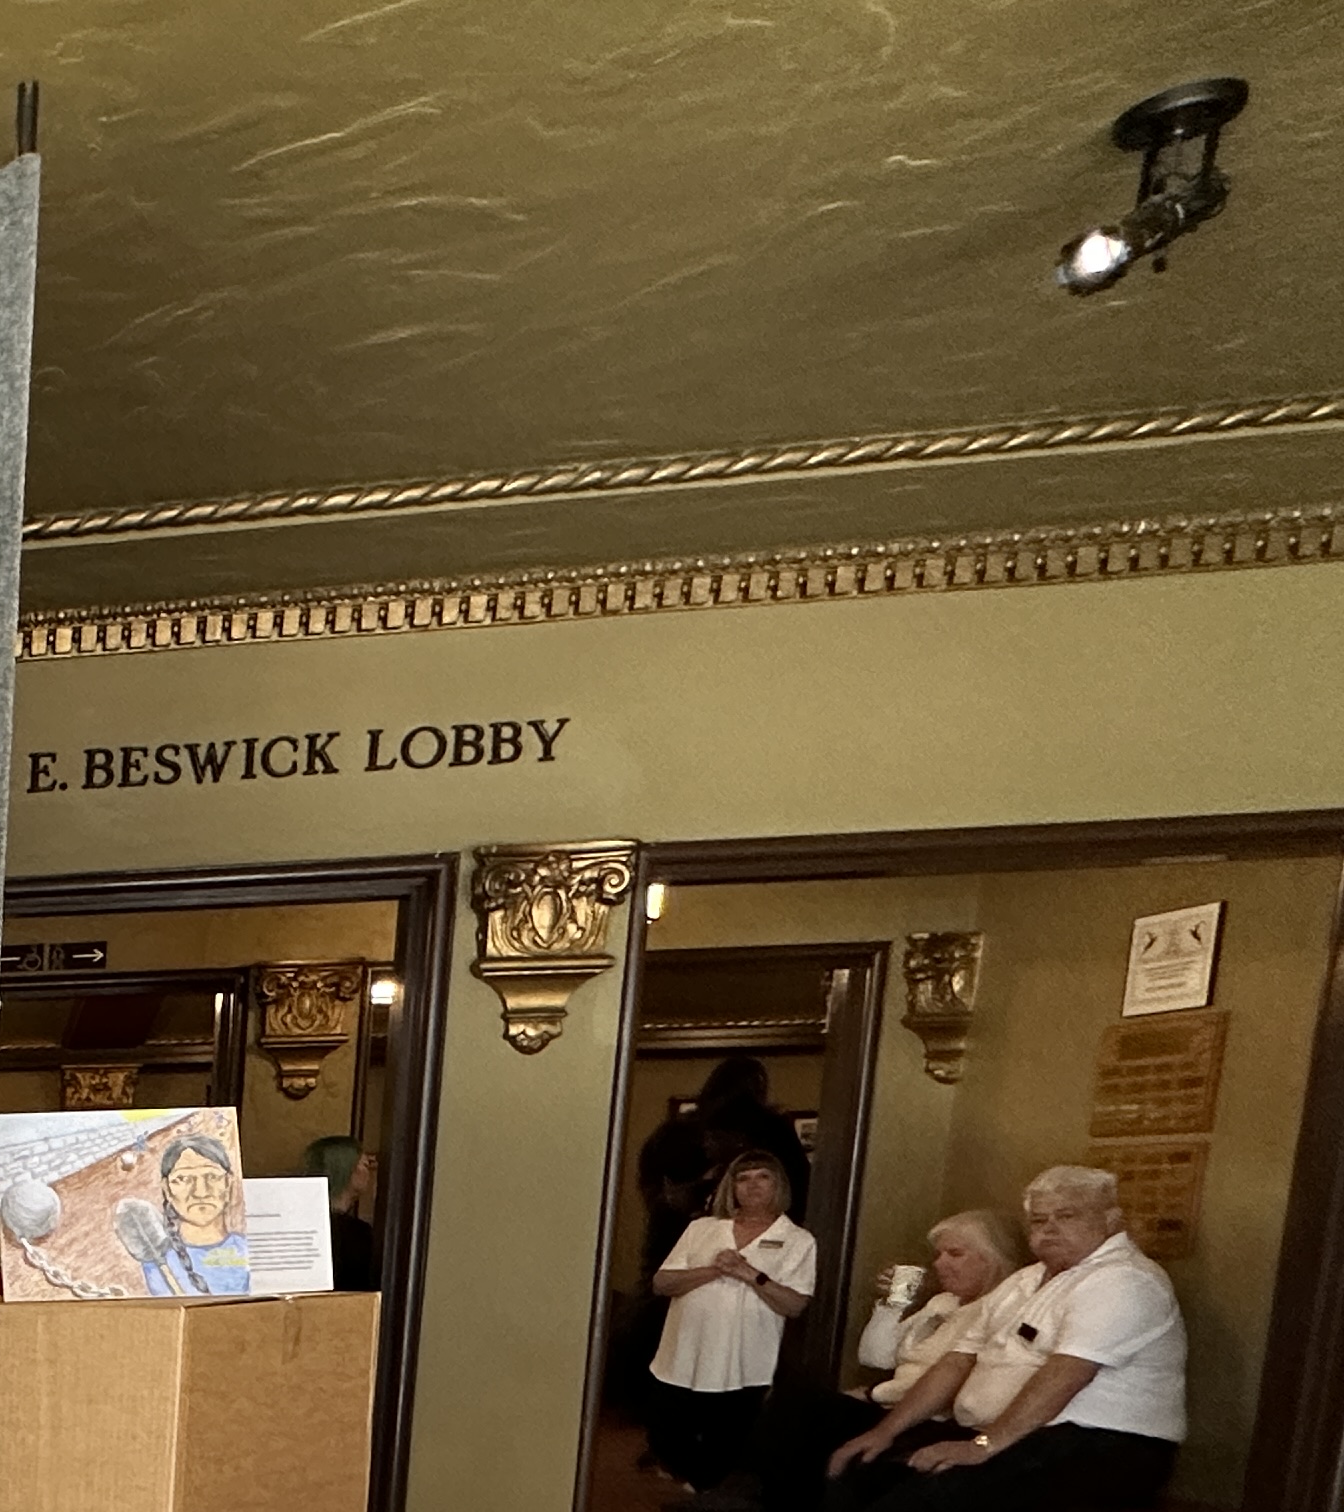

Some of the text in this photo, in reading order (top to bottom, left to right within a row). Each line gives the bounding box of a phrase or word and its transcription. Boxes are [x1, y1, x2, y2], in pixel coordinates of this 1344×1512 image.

[26, 717, 571, 794] E. BESWICK LOBBY
